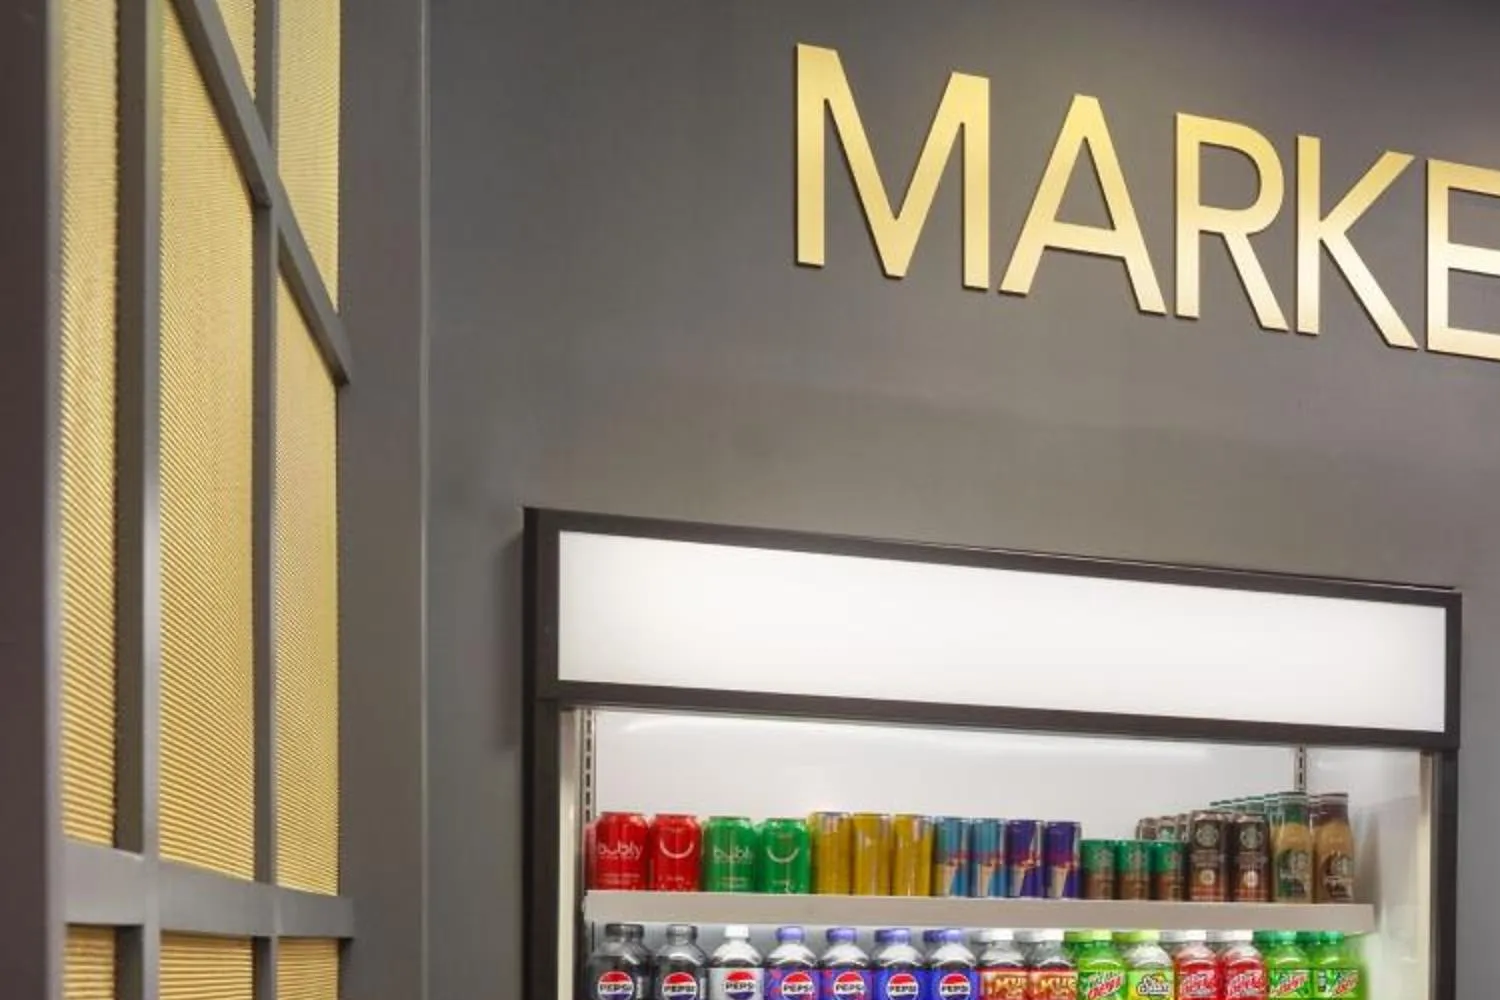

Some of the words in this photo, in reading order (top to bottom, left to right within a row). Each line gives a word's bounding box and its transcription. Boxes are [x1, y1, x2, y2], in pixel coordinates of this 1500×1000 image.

[599, 982, 634, 993] PEPSI
[664, 983, 698, 993] PEPSI
[889, 984, 917, 993] PEPSI
[941, 984, 969, 993] PEPSI
